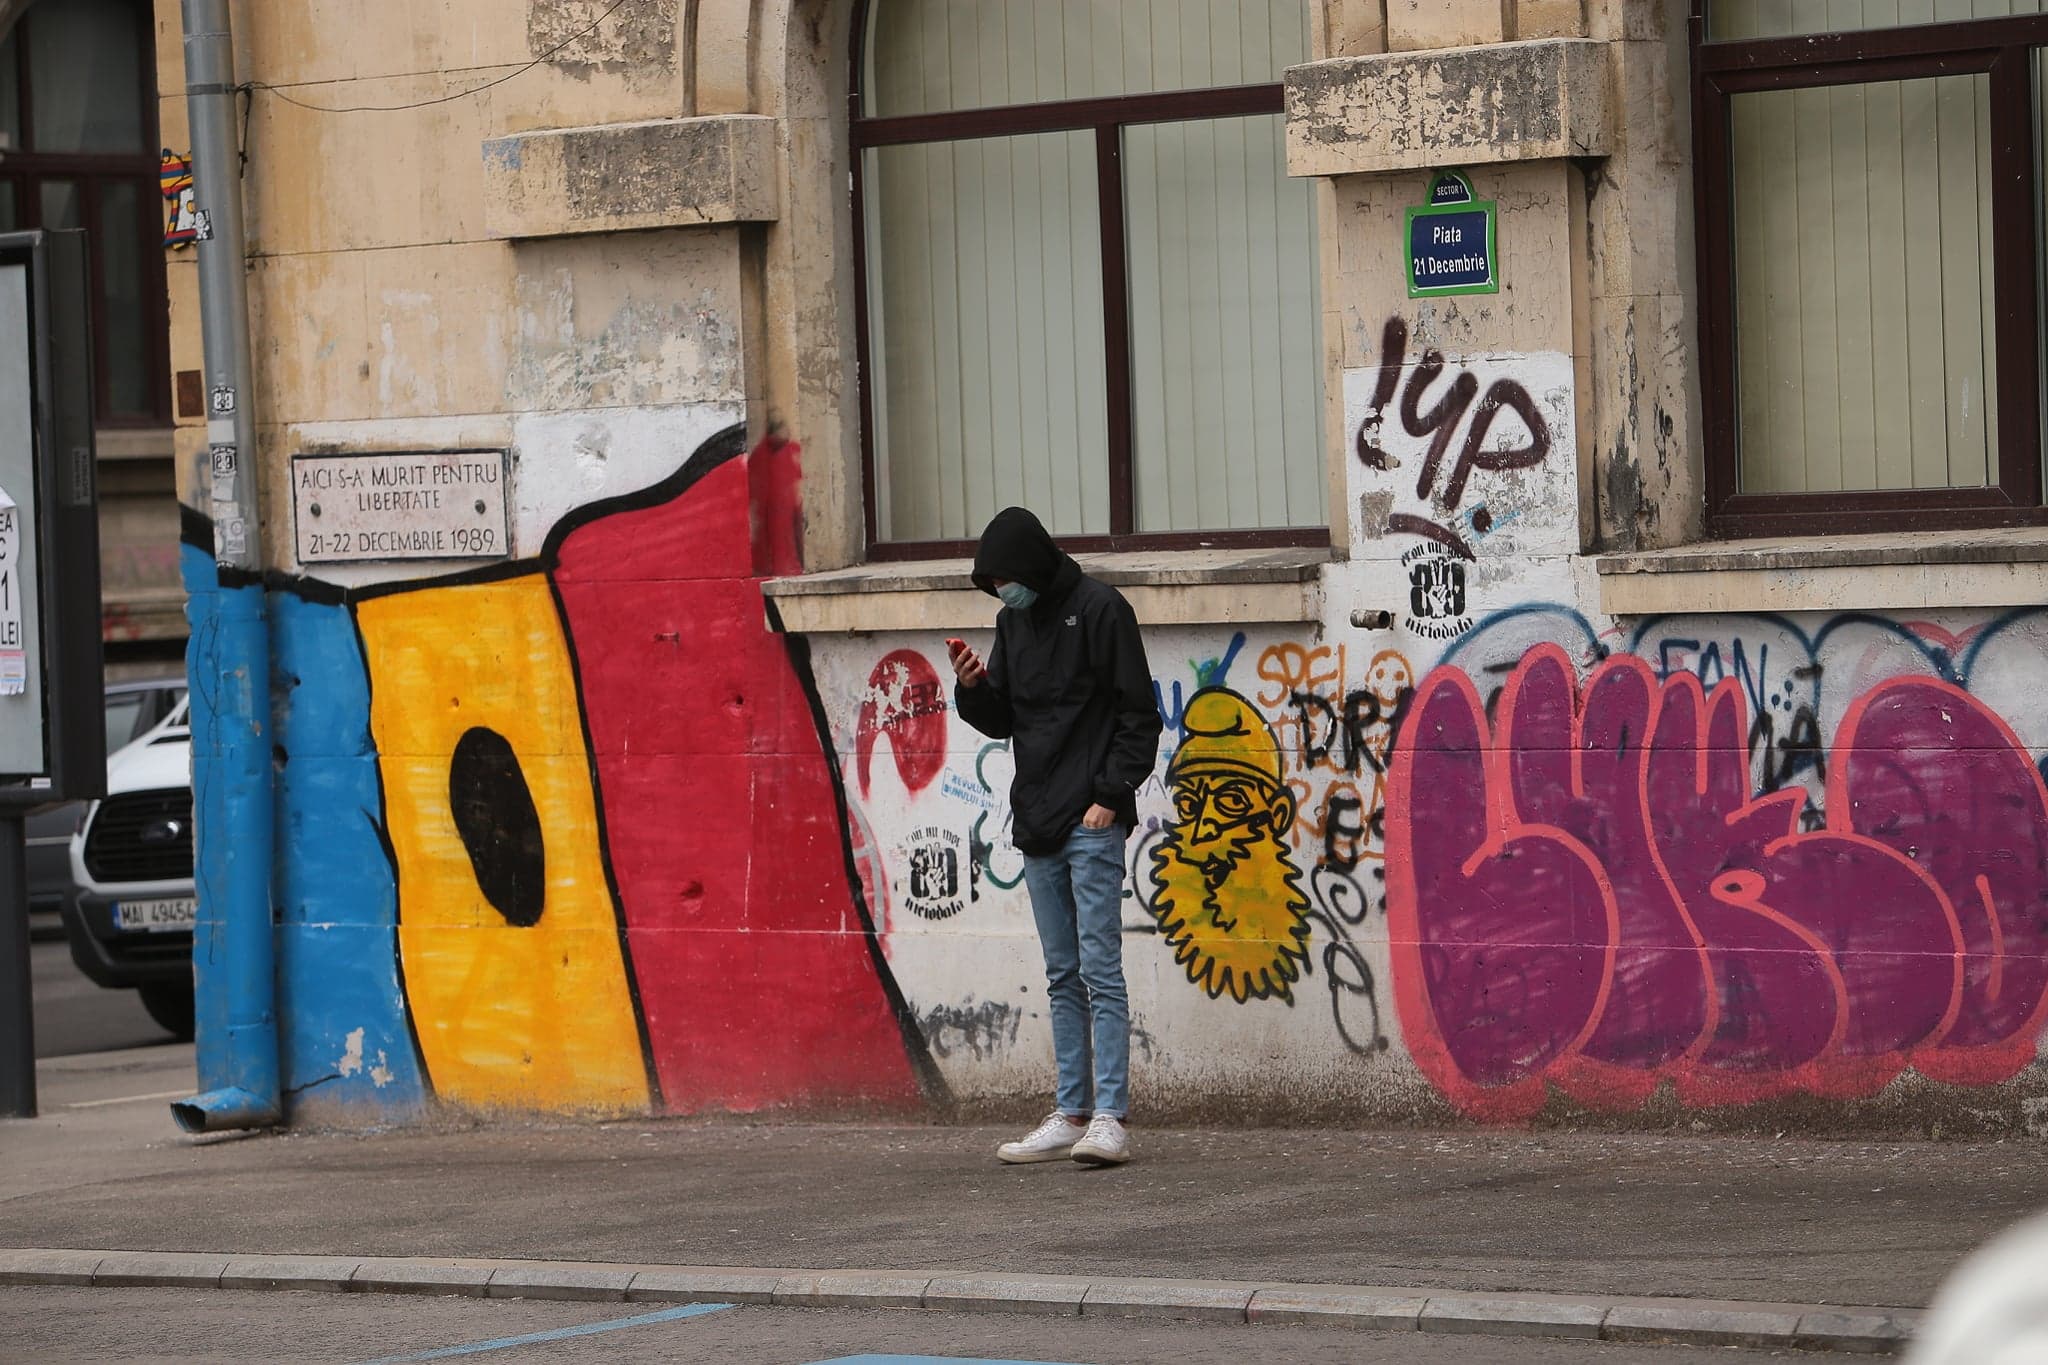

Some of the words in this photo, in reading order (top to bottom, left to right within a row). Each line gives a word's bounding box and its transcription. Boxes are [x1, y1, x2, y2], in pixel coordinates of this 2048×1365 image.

[1436, 185, 1459, 196] SECTOR
[1413, 257, 1426, 275] 21
[1428, 252, 1485, 275] Decembrie
[302, 468, 332, 489] AICI
[339, 467, 364, 489] S-A
[371, 465, 426, 487] MURIT
[433, 463, 497, 485] PENTRU
[359, 489, 441, 512] LIBERTATE
[310, 532, 351, 554] 21-22
[359, 530, 445, 552] DECEMBRIE
[450, 528, 495, 553] 1989
[1, 621, 20, 645] LEI
